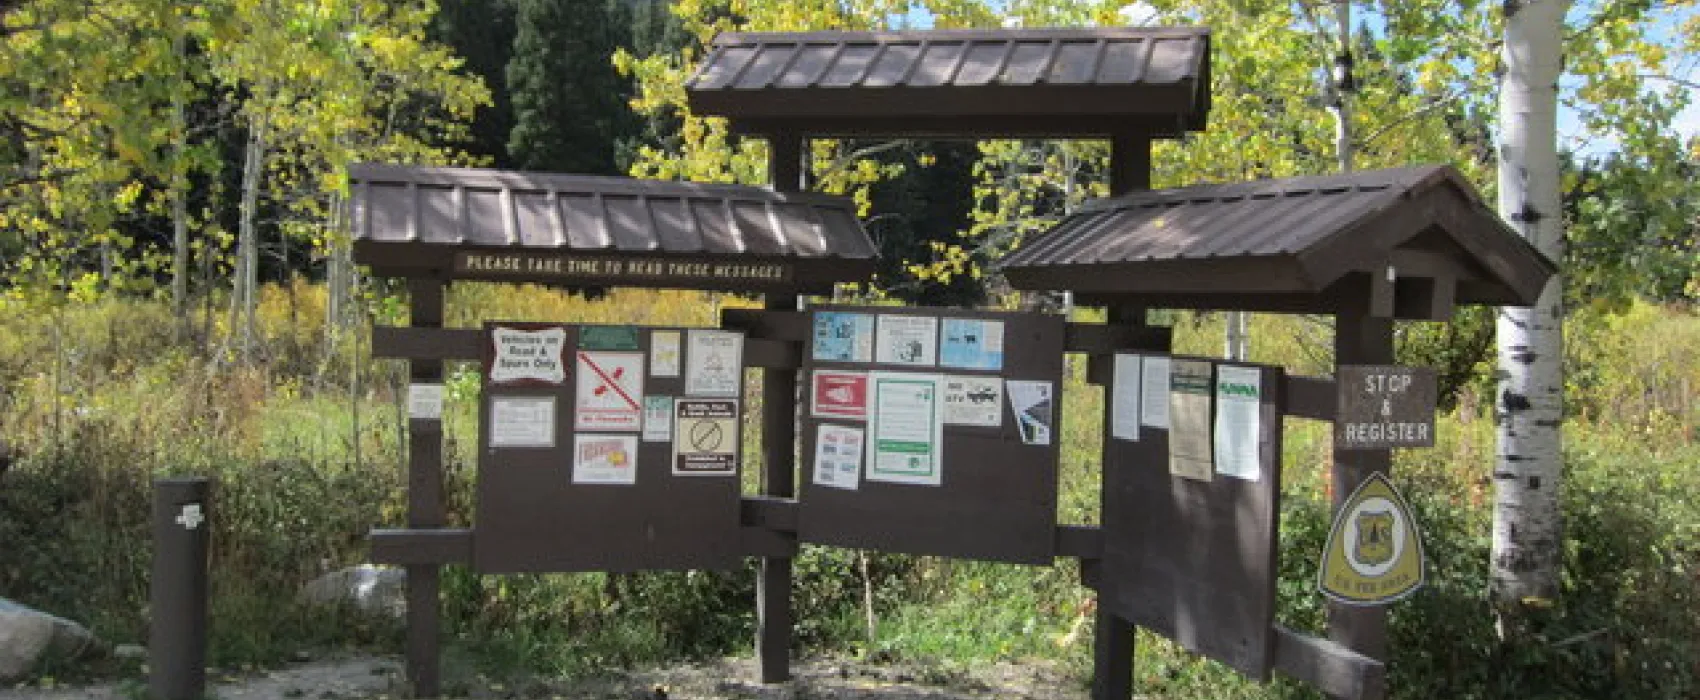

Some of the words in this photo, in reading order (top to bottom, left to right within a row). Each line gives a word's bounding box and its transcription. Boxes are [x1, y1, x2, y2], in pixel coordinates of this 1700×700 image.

[467, 255, 519, 270] PLEASE
[528, 258, 561, 272] TAKE
[568, 260, 599, 274] TIME
[605, 260, 622, 275] TO
[628, 261, 662, 275] READ
[669, 262, 709, 276] THESE
[714, 264, 782, 279] MESSAGES
[501, 335, 541, 344] Vehicles
[510, 346, 535, 355] Road
[534, 359, 556, 370] Only
[1365, 374, 1411, 392] STOP
[1381, 398, 1392, 415] &
[1346, 422, 1427, 442] REGISTER
